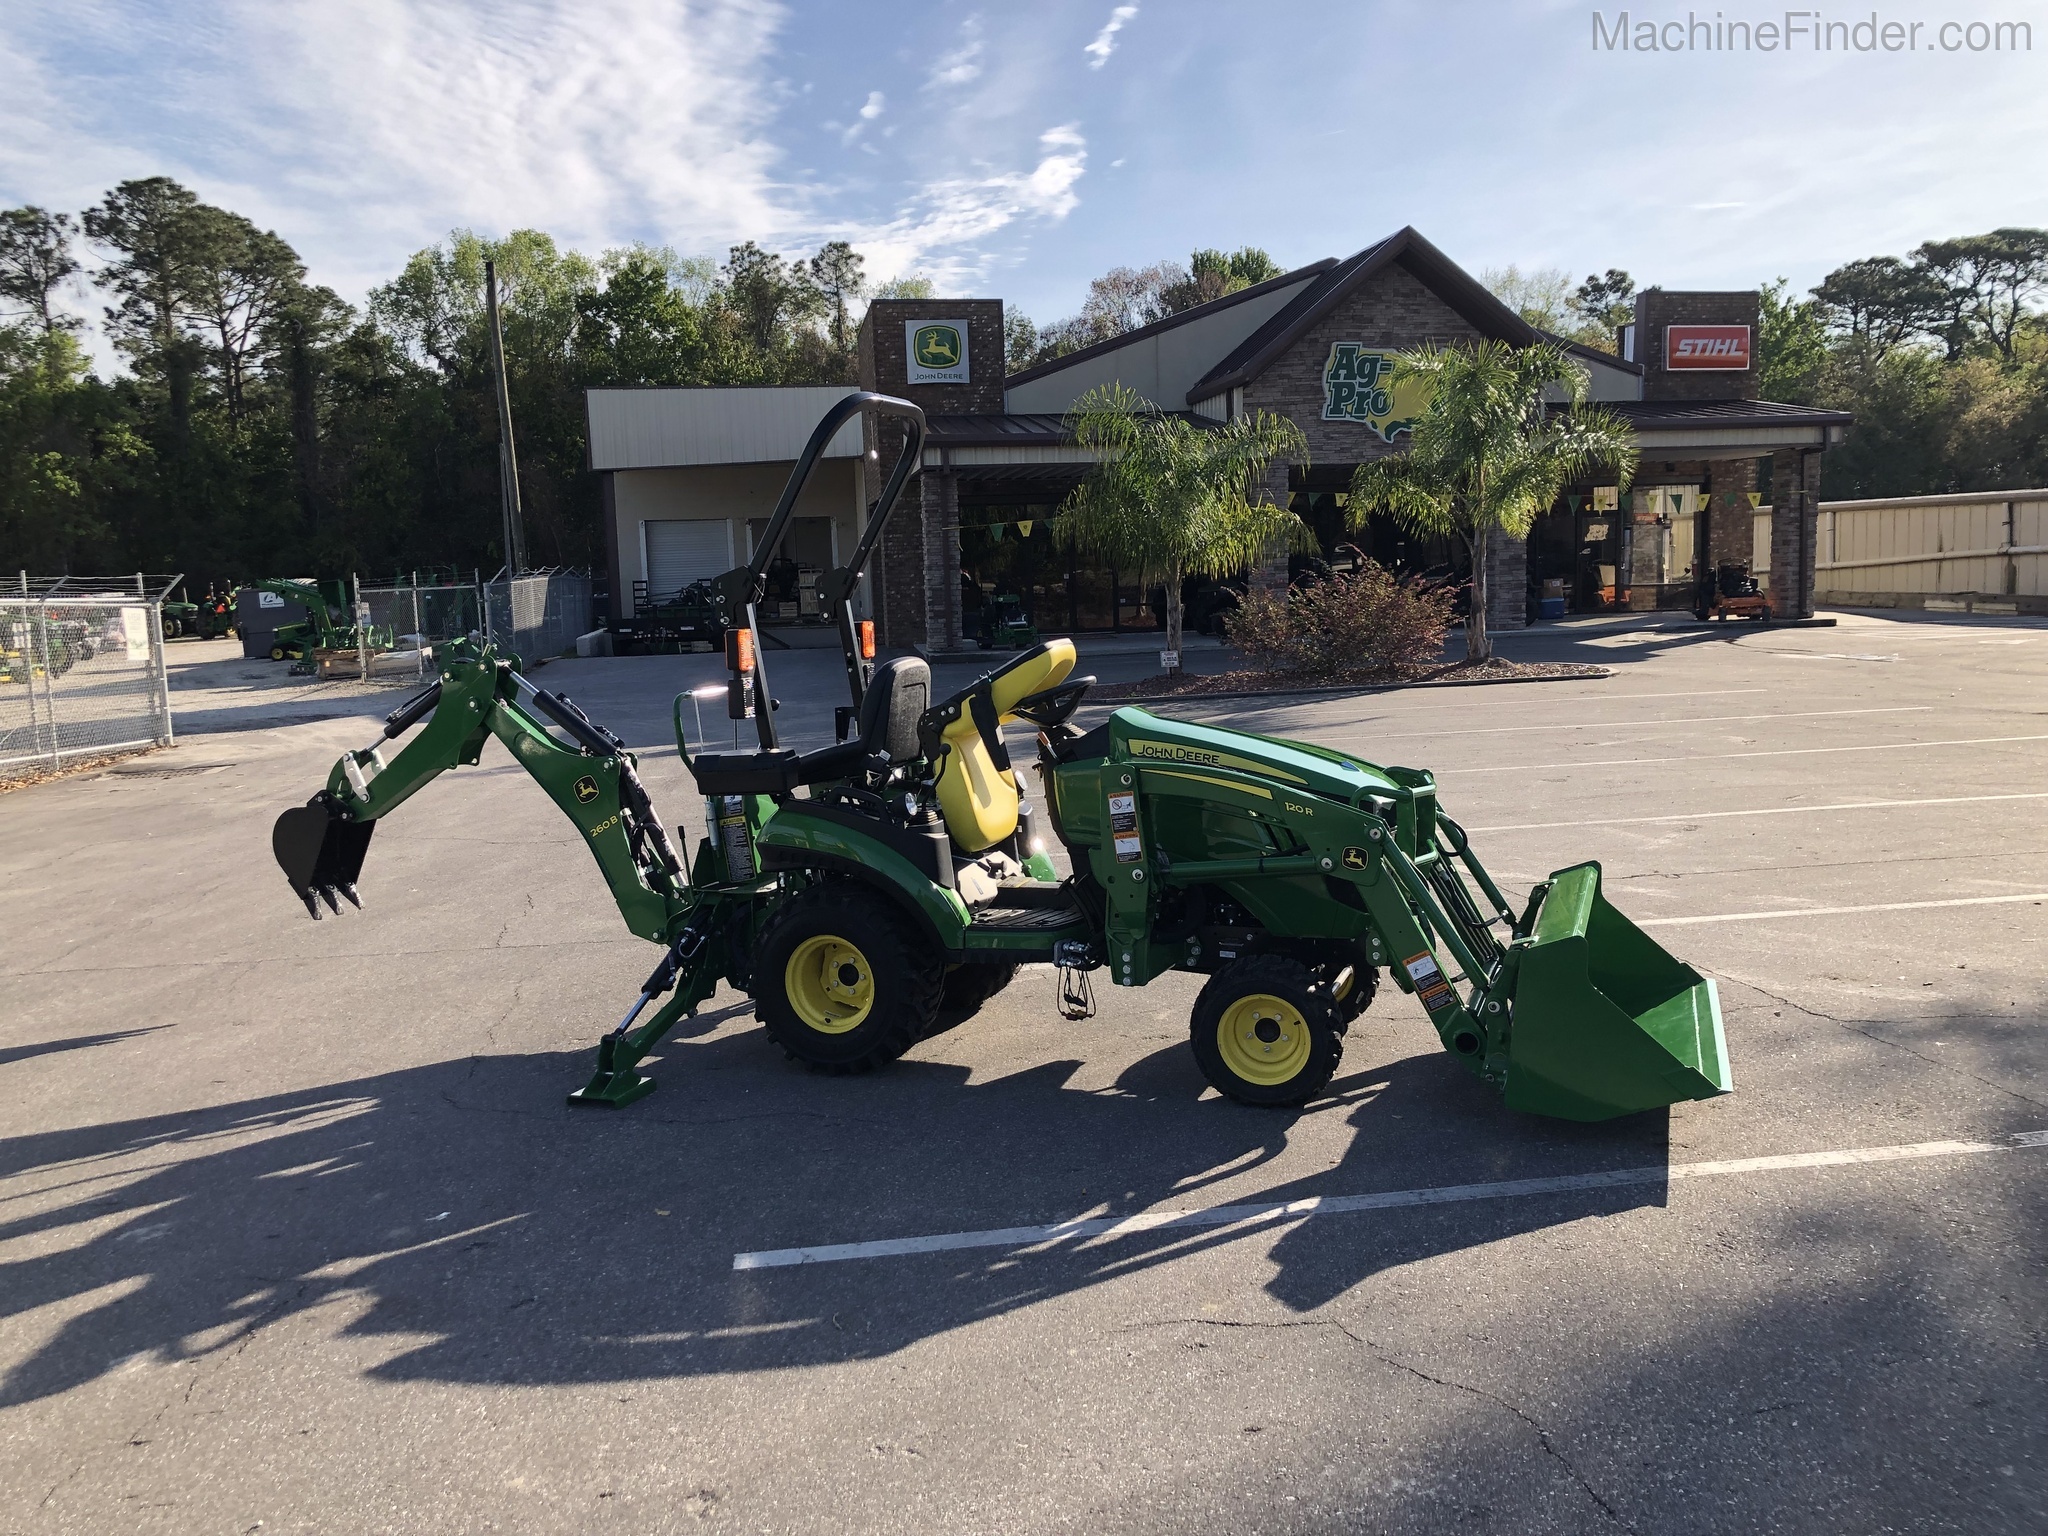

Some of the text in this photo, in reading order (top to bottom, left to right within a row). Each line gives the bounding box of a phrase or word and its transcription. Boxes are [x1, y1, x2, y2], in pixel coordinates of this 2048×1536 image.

[1675, 338, 1744, 356] STIHL
[1328, 345, 1394, 389] Ag-
[1327, 381, 1394, 417] Pro
[1138, 744, 1220, 764] JOHN DEERE
[1285, 802, 1314, 816] 120 R
[590, 815, 618, 837] 260 B
